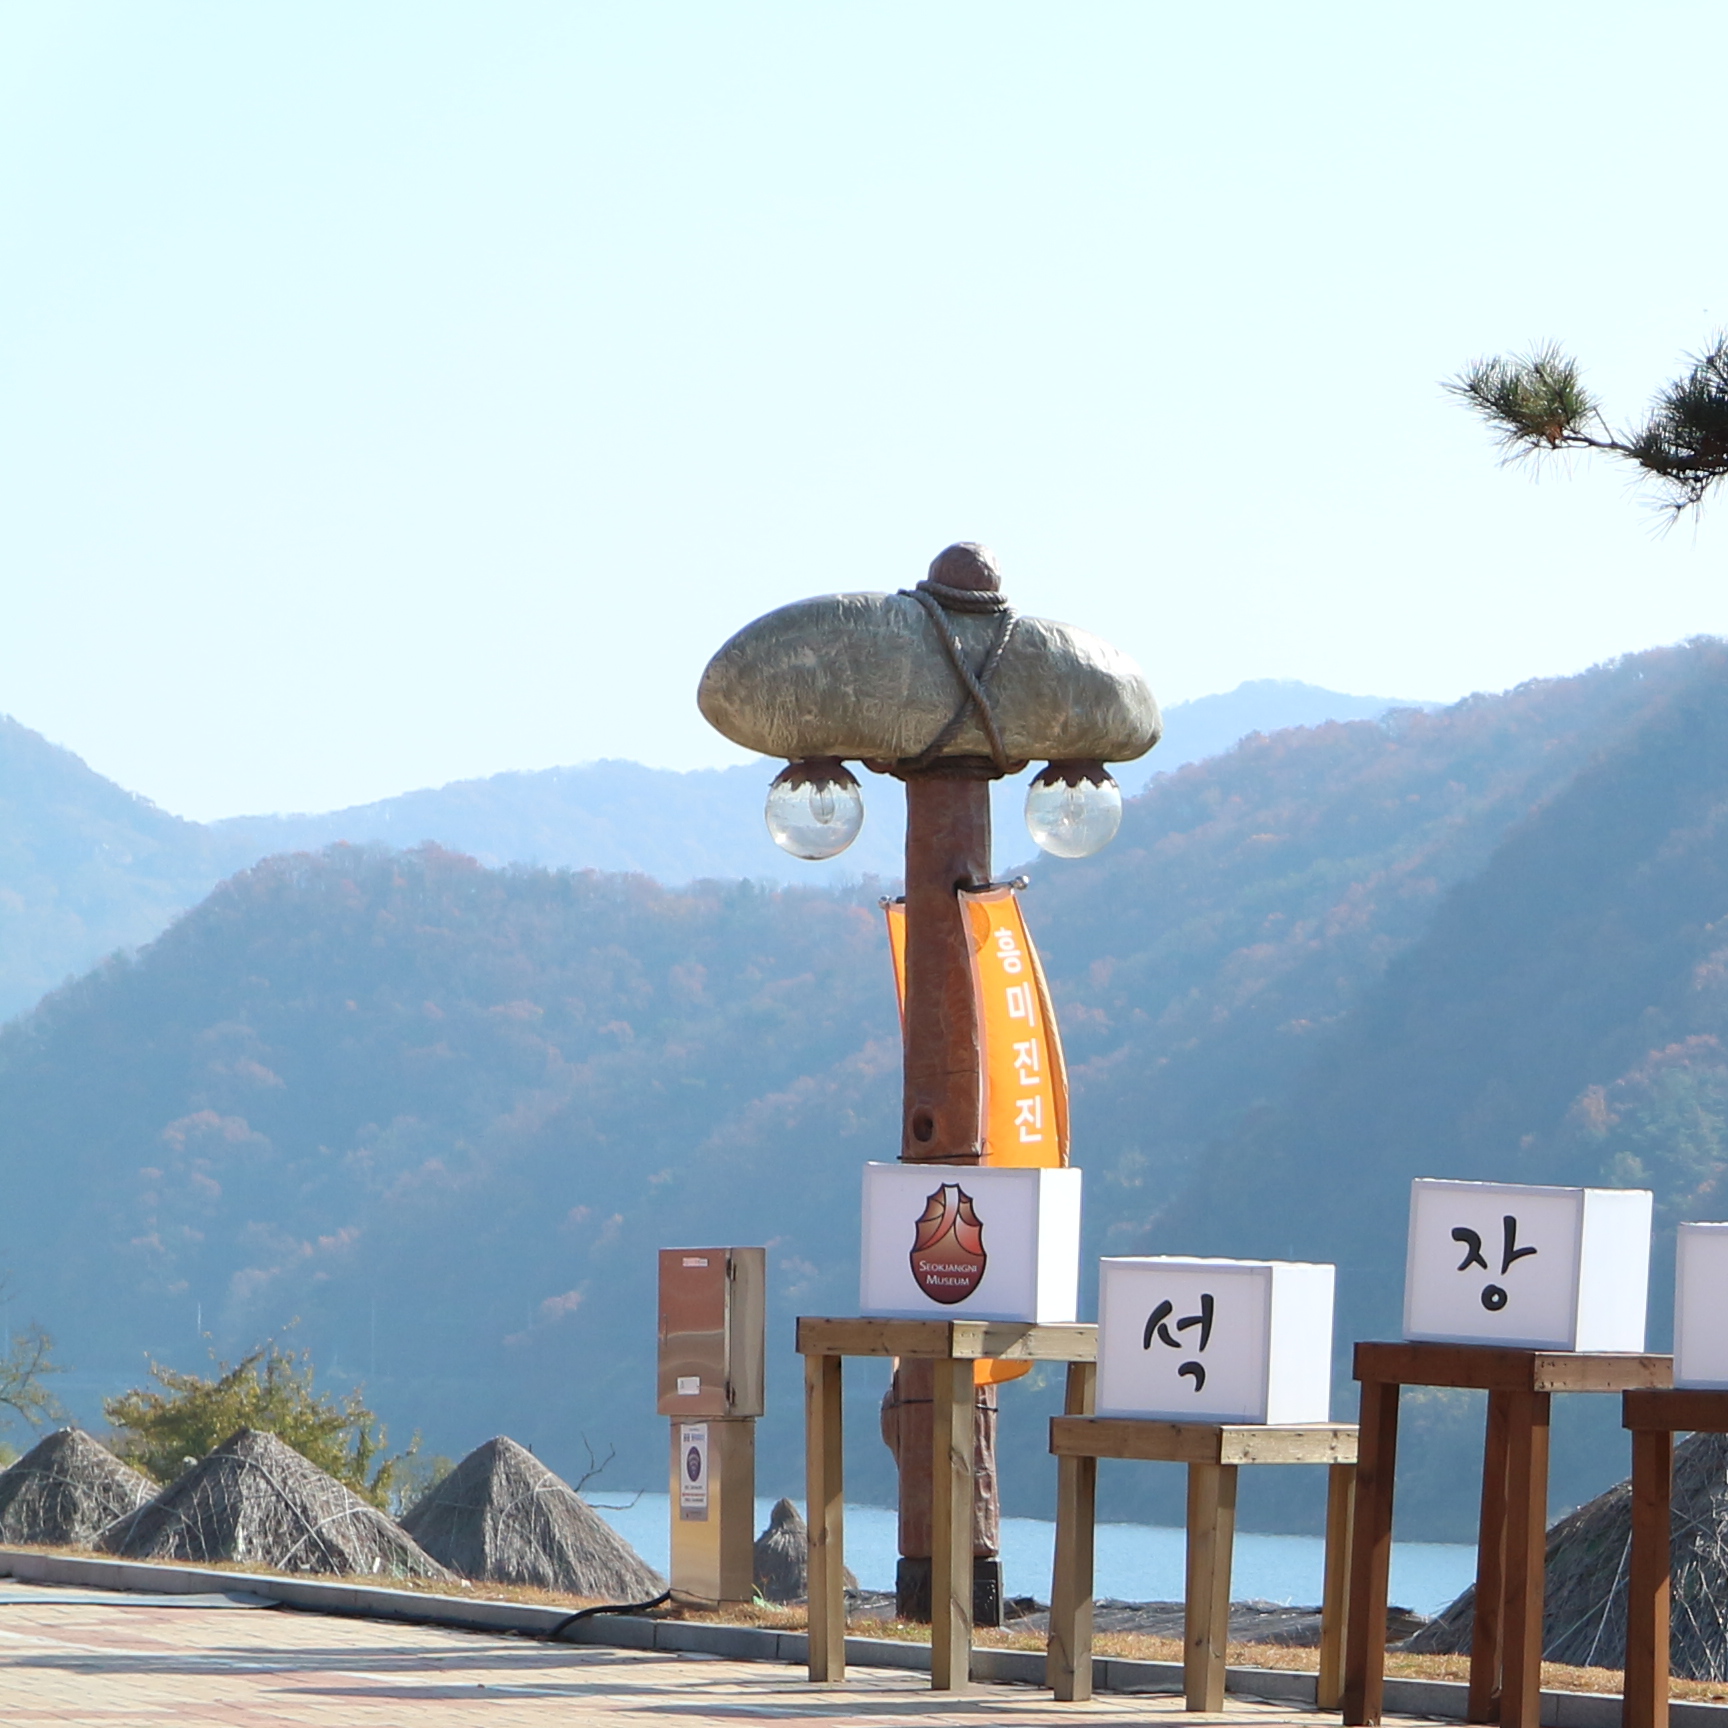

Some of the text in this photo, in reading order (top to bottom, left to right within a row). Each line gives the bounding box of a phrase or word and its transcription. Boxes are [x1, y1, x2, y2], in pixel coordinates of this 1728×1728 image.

[993, 926, 1043, 1143] 흥미진진
[1451, 1215, 1538, 1312] 장
[1143, 1293, 1215, 1393] 석
